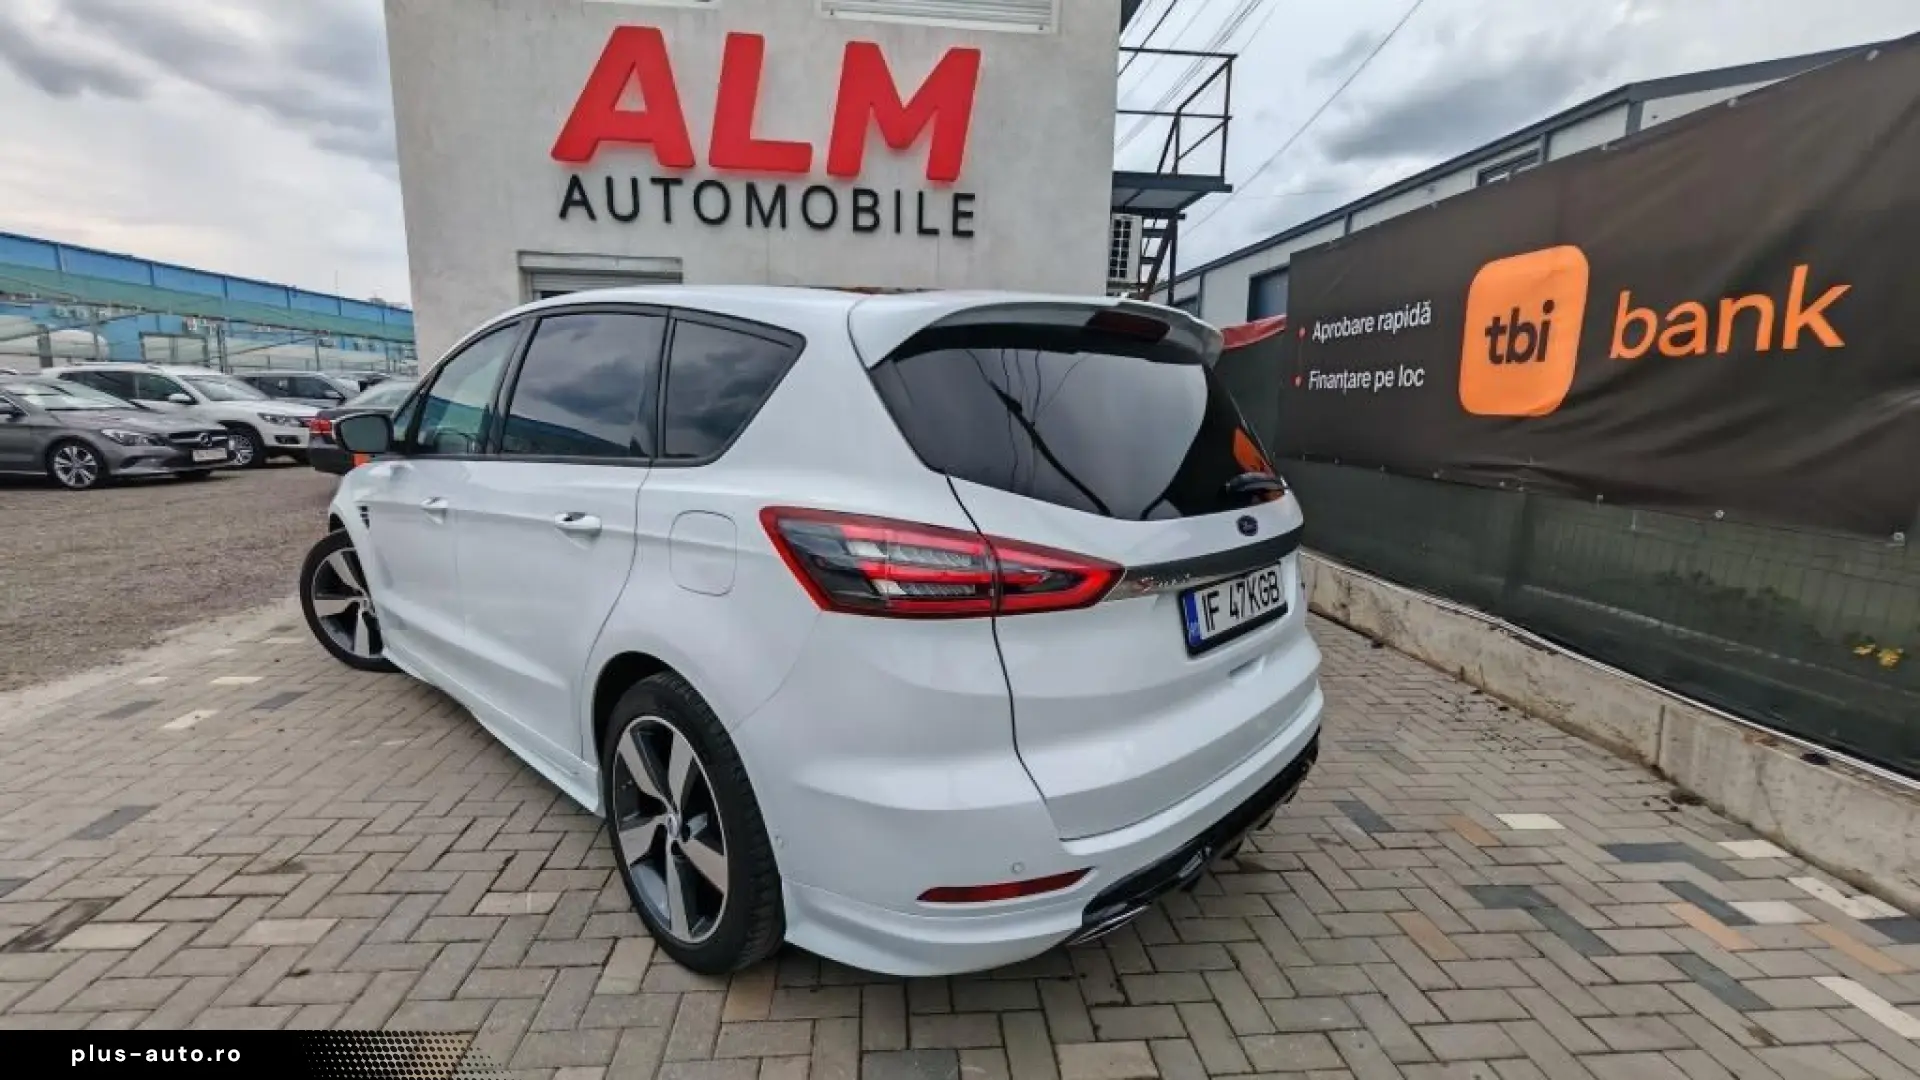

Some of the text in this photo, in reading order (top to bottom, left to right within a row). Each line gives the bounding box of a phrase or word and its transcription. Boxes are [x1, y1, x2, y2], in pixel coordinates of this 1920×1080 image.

[550, 25, 982, 182] ALM
[558, 173, 977, 239] AUTOMOBILE
[1311, 299, 1432, 344] Aprobare rapidă
[1484, 263, 1852, 365] tbi bank
[1374, 369, 1394, 393] pe
[1398, 363, 1425, 388] loc
[1201, 590, 1219, 632] IF
